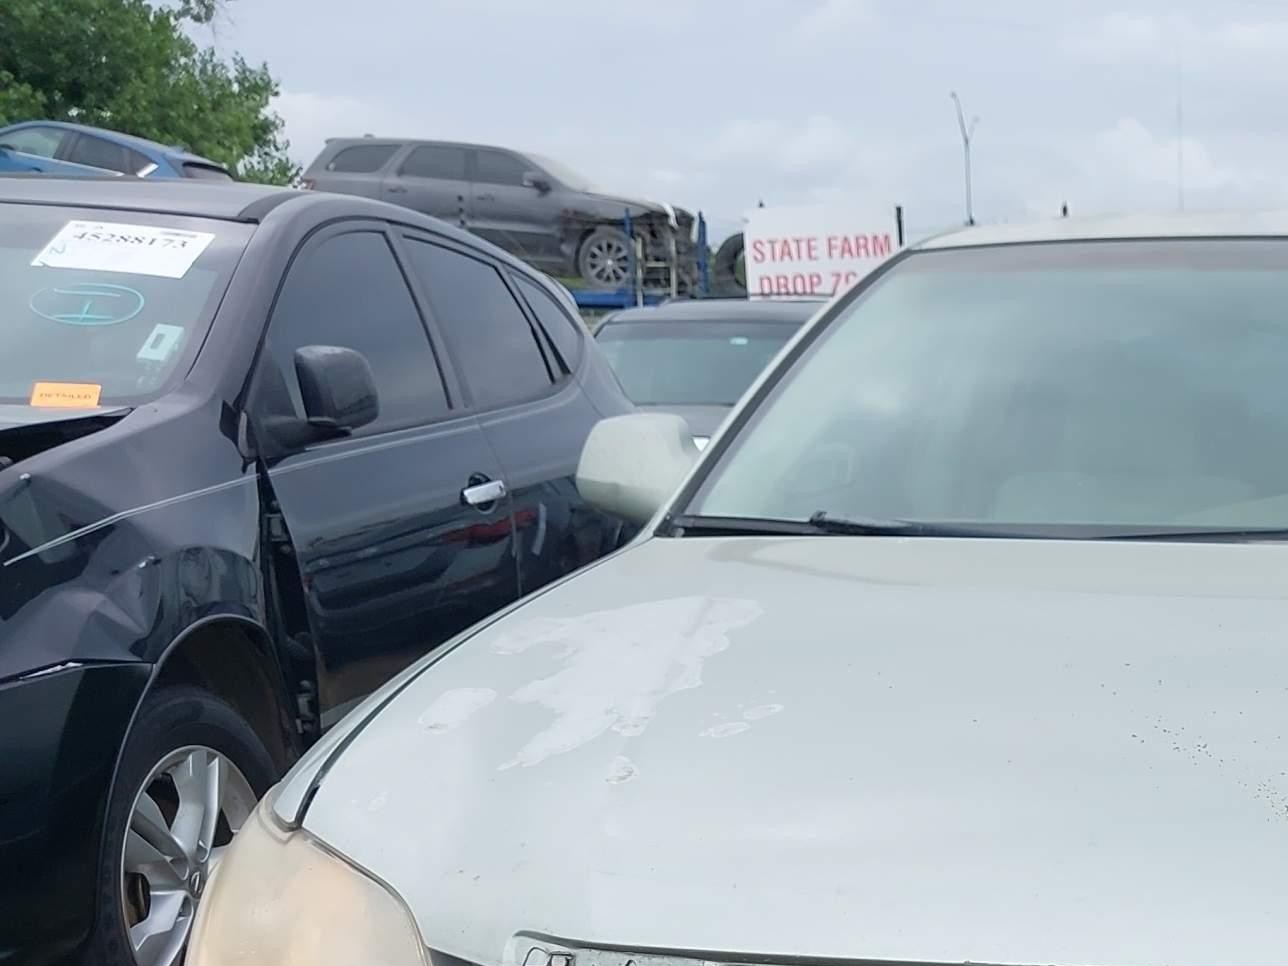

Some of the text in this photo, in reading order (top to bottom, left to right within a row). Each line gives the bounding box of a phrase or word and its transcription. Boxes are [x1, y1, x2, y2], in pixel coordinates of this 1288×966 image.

[73, 231, 189, 249] 45288173
[752, 233, 892, 264] STATE FARM
[759, 272, 822, 297] DROP
